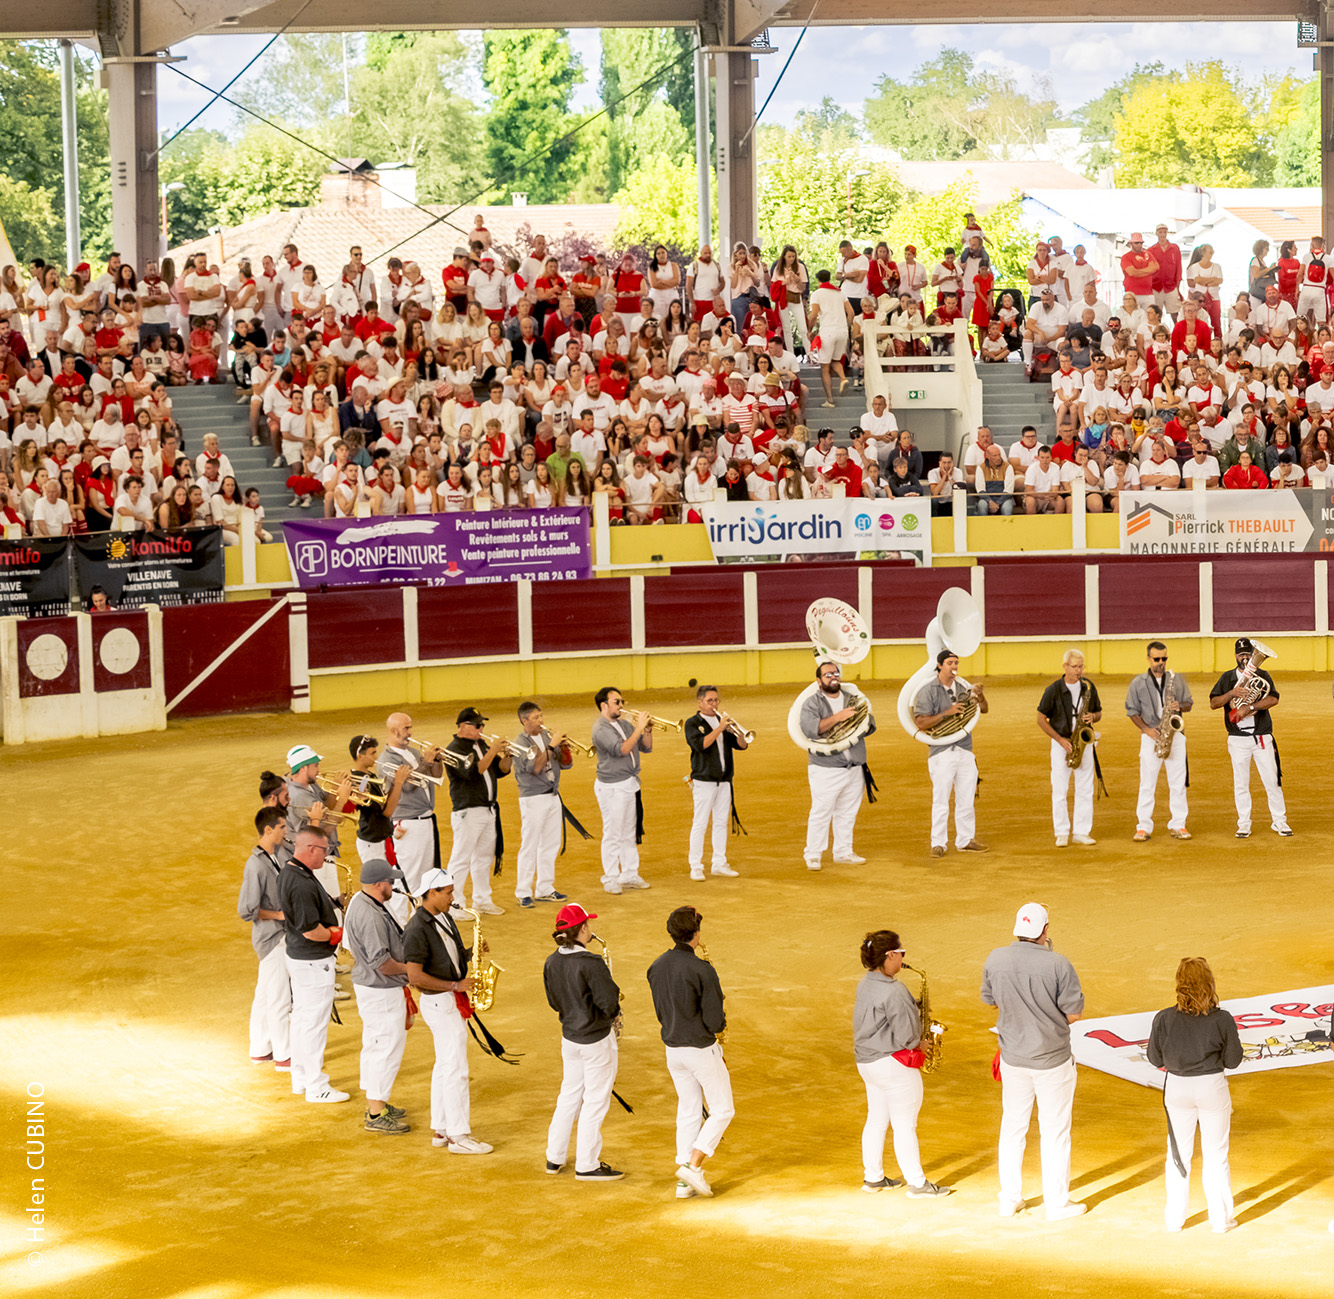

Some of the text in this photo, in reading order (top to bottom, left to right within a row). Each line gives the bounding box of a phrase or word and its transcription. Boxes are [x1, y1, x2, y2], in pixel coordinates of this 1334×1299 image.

[455, 514, 581, 531] Peinture Intérieure & Extérieure
[1175, 519, 1296, 534] Pierrick THEBAULT
[469, 530, 569, 545] Revêtements sols & murs
[131, 537, 192, 556] komilfo
[461, 542, 581, 562] Vente peinture professionnelle
[1226, 538, 1296, 554] GÉNÉRALE
[331, 545, 447, 569] BORNPEINTURE
[127, 570, 172, 582] VILLENAVE
[524, 572, 536, 581] 73
[122, 583, 152, 592] PARENTIS
[153, 582, 162, 590] EN
[1084, 1013, 1286, 1049] Ls
